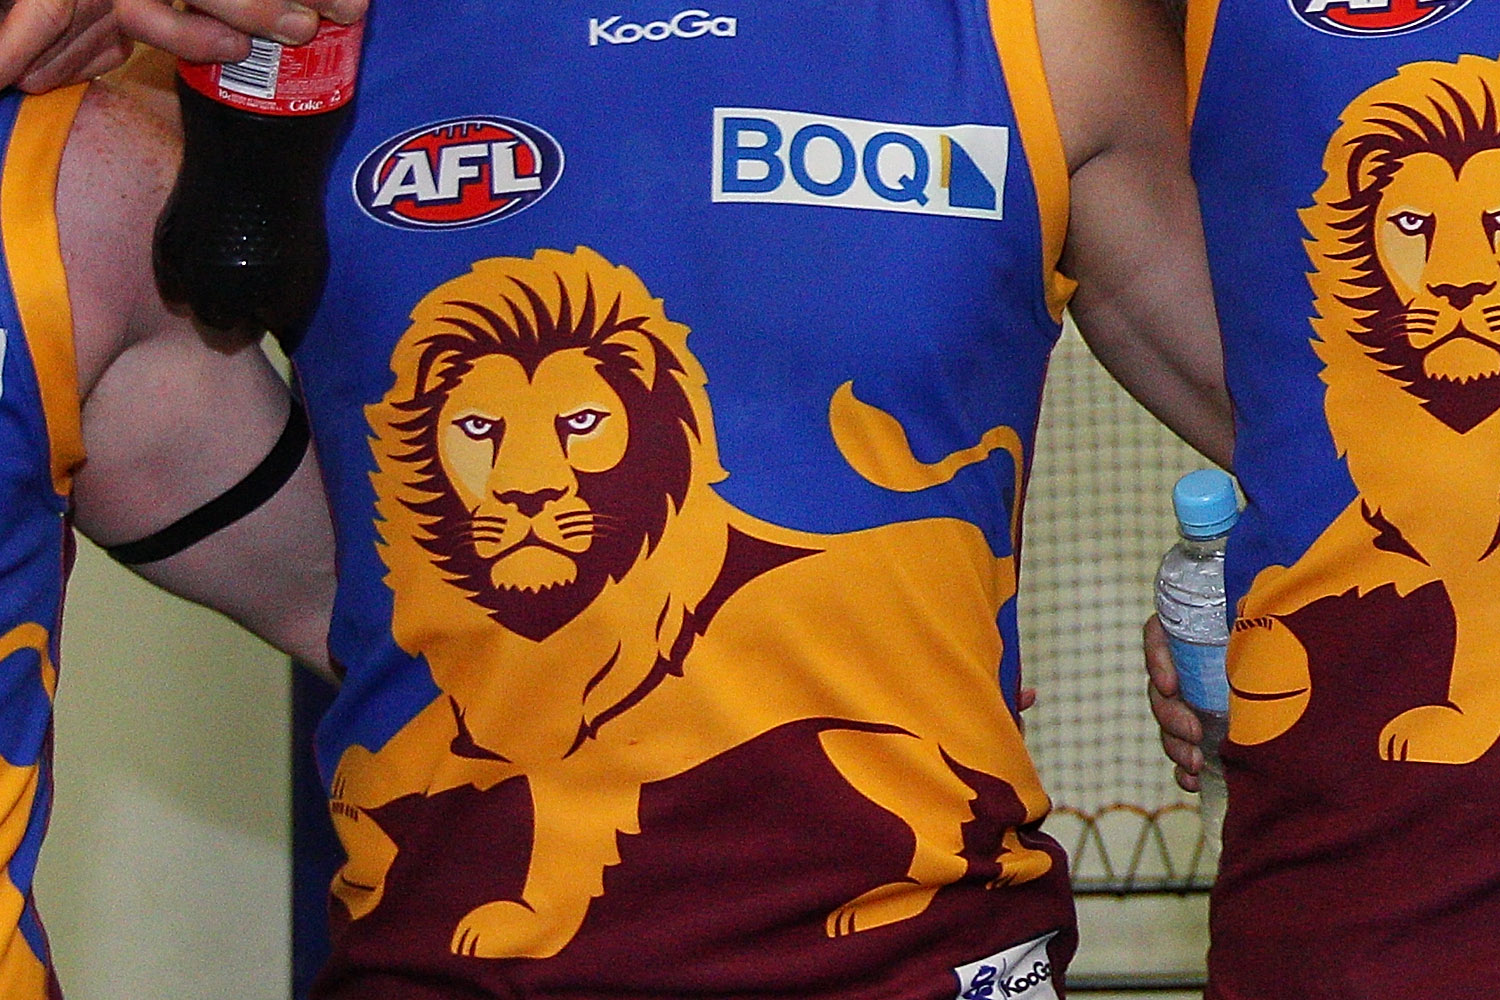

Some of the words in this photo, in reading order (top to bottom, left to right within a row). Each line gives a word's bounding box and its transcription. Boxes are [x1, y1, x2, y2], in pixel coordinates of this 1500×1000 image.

[589, 9, 737, 46] KooGa
[289, 99, 324, 112] Coke
[371, 139, 542, 207] AFL
[721, 116, 930, 207] BOQ
